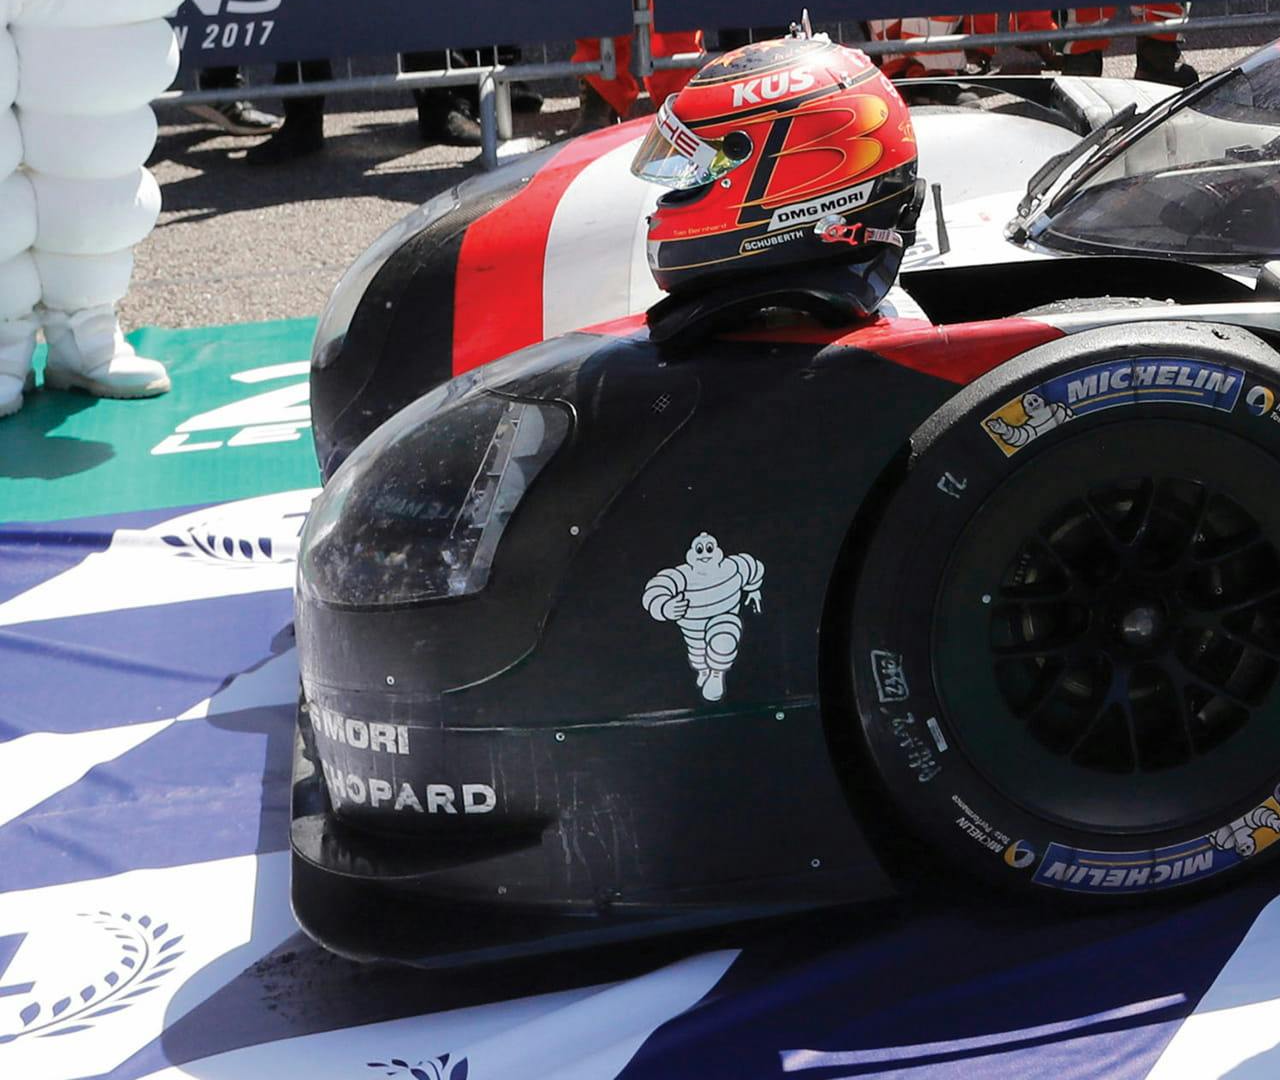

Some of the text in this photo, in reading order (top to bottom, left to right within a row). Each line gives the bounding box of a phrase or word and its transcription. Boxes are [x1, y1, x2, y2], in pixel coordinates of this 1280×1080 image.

[202, 21, 275, 49] 2017
[776, 189, 865, 224] DMG MORI
[744, 230, 805, 252] SCHUBERTH
[1066, 364, 1238, 403] MICHELIN
[1045, 850, 1214, 886] MICHELIN
